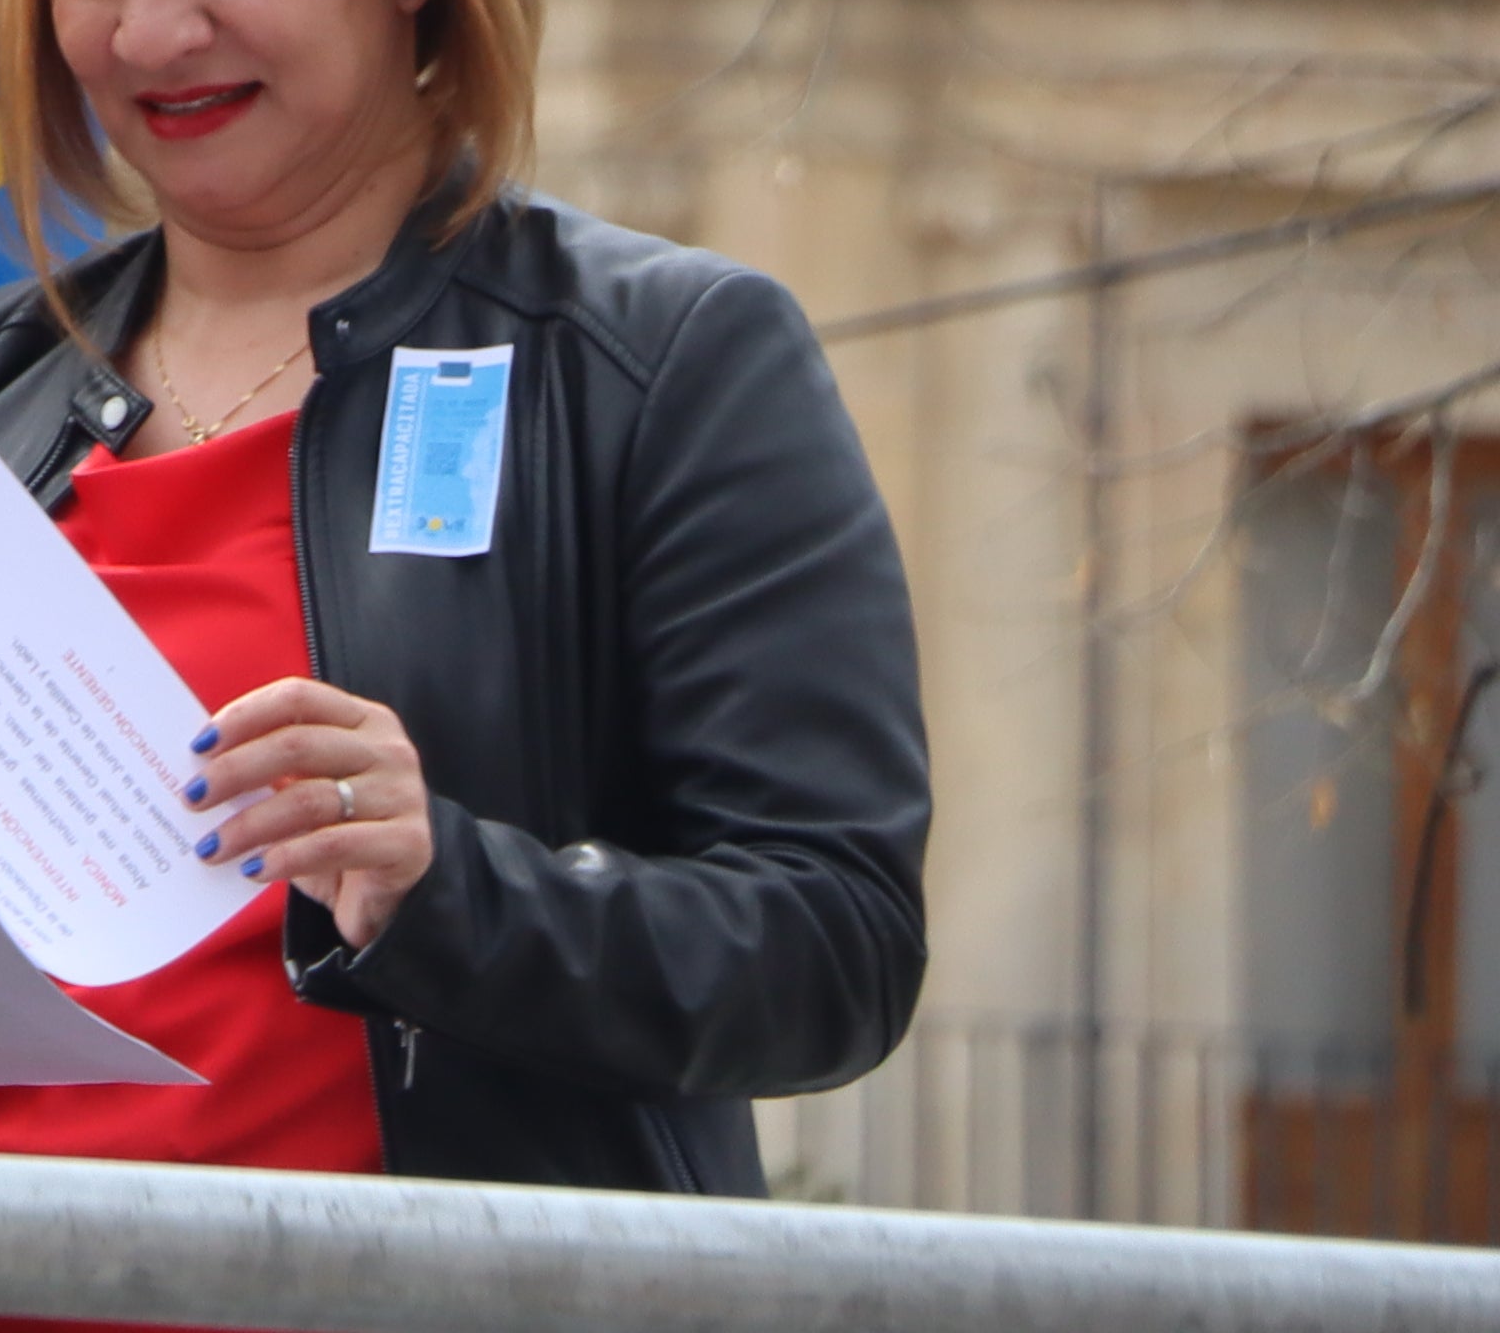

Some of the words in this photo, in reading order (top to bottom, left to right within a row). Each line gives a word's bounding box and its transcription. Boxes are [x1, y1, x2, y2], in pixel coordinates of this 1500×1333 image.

[36, 667, 50, 680] y
[58, 646, 119, 714] GERENTE
[27, 704, 44, 721] la
[40, 677, 85, 726] Castilla
[38, 718, 60, 740] de
[76, 722, 97, 744] de
[29, 750, 53, 775] dar
[53, 736, 101, 790] Gerente
[89, 739, 124, 776] Junta
[108, 710, 186, 798] TERVENCIÓN
[51, 773, 99, 827] gustaría
[118, 774, 136, 791] la
[128, 786, 149, 808] de
[95, 787, 131, 827] actual
[95, 826, 118, 851] me
[142, 803, 191, 858] Sociales
[114, 852, 151, 892] Ahora
